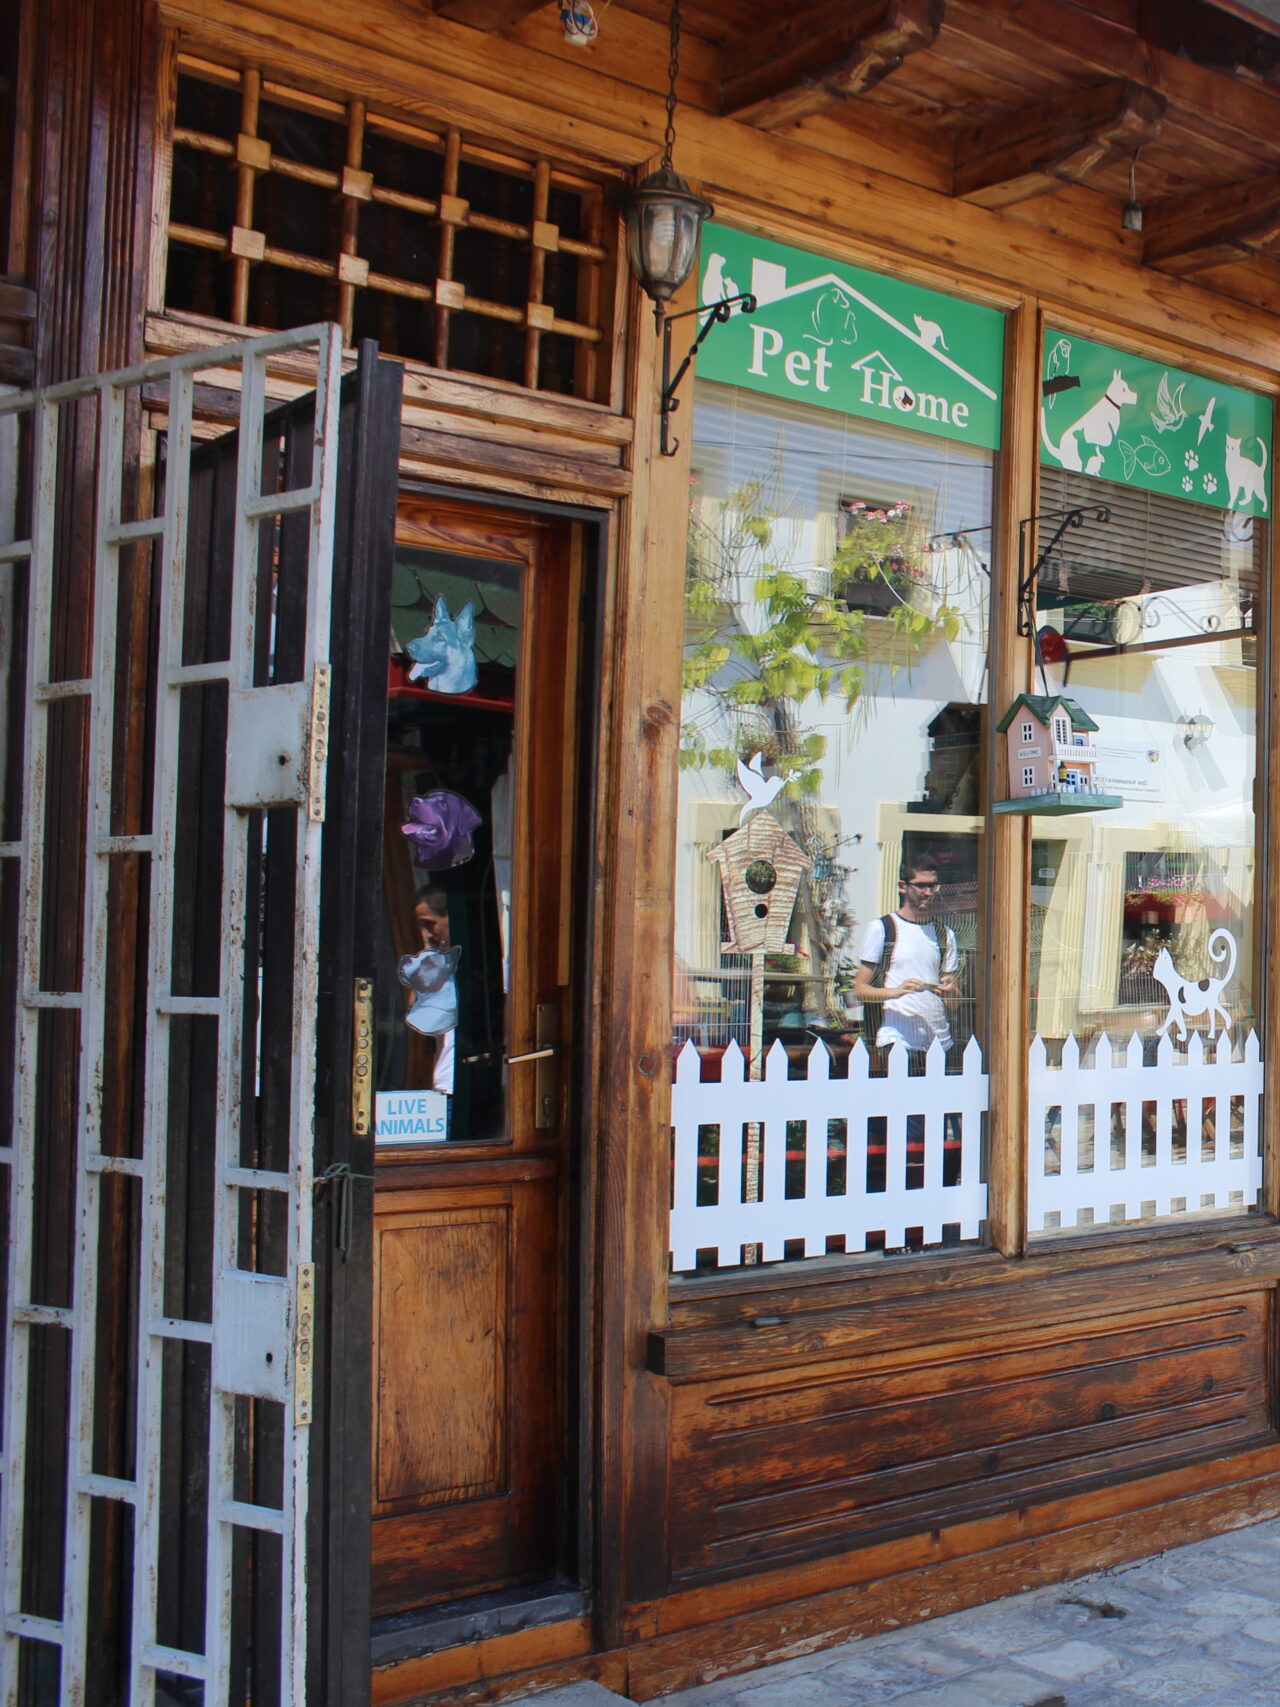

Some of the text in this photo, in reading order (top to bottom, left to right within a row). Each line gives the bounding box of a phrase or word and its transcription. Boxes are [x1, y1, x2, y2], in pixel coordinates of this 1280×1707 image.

[747, 323, 970, 428] Pet Home
[387, 1098, 427, 1116] LIVE
